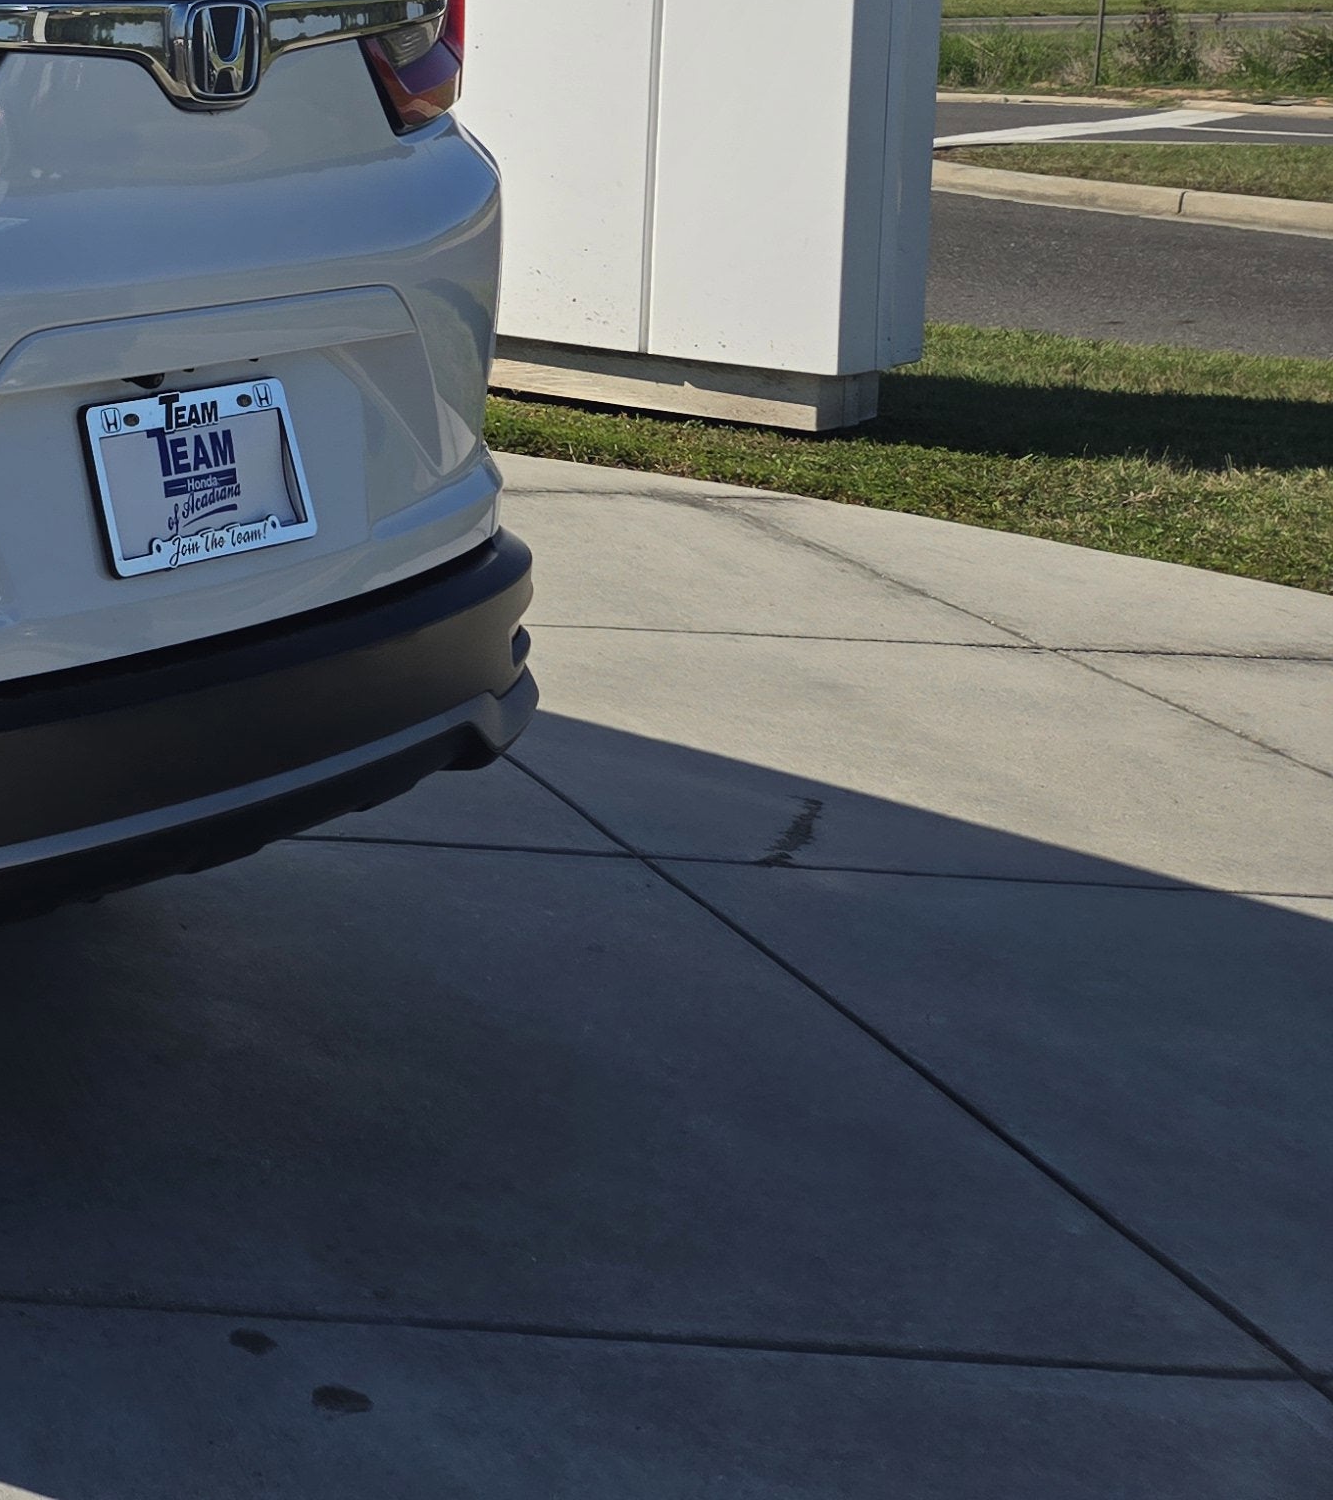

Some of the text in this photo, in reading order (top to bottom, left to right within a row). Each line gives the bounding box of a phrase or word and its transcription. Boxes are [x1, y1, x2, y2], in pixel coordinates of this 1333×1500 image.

[159, 393, 219, 431] TEAM
[146, 428, 236, 477] TEAM
[187, 475, 219, 491] Honda
[168, 483, 242, 534] of Acadiana
[169, 536, 201, 566] Join
